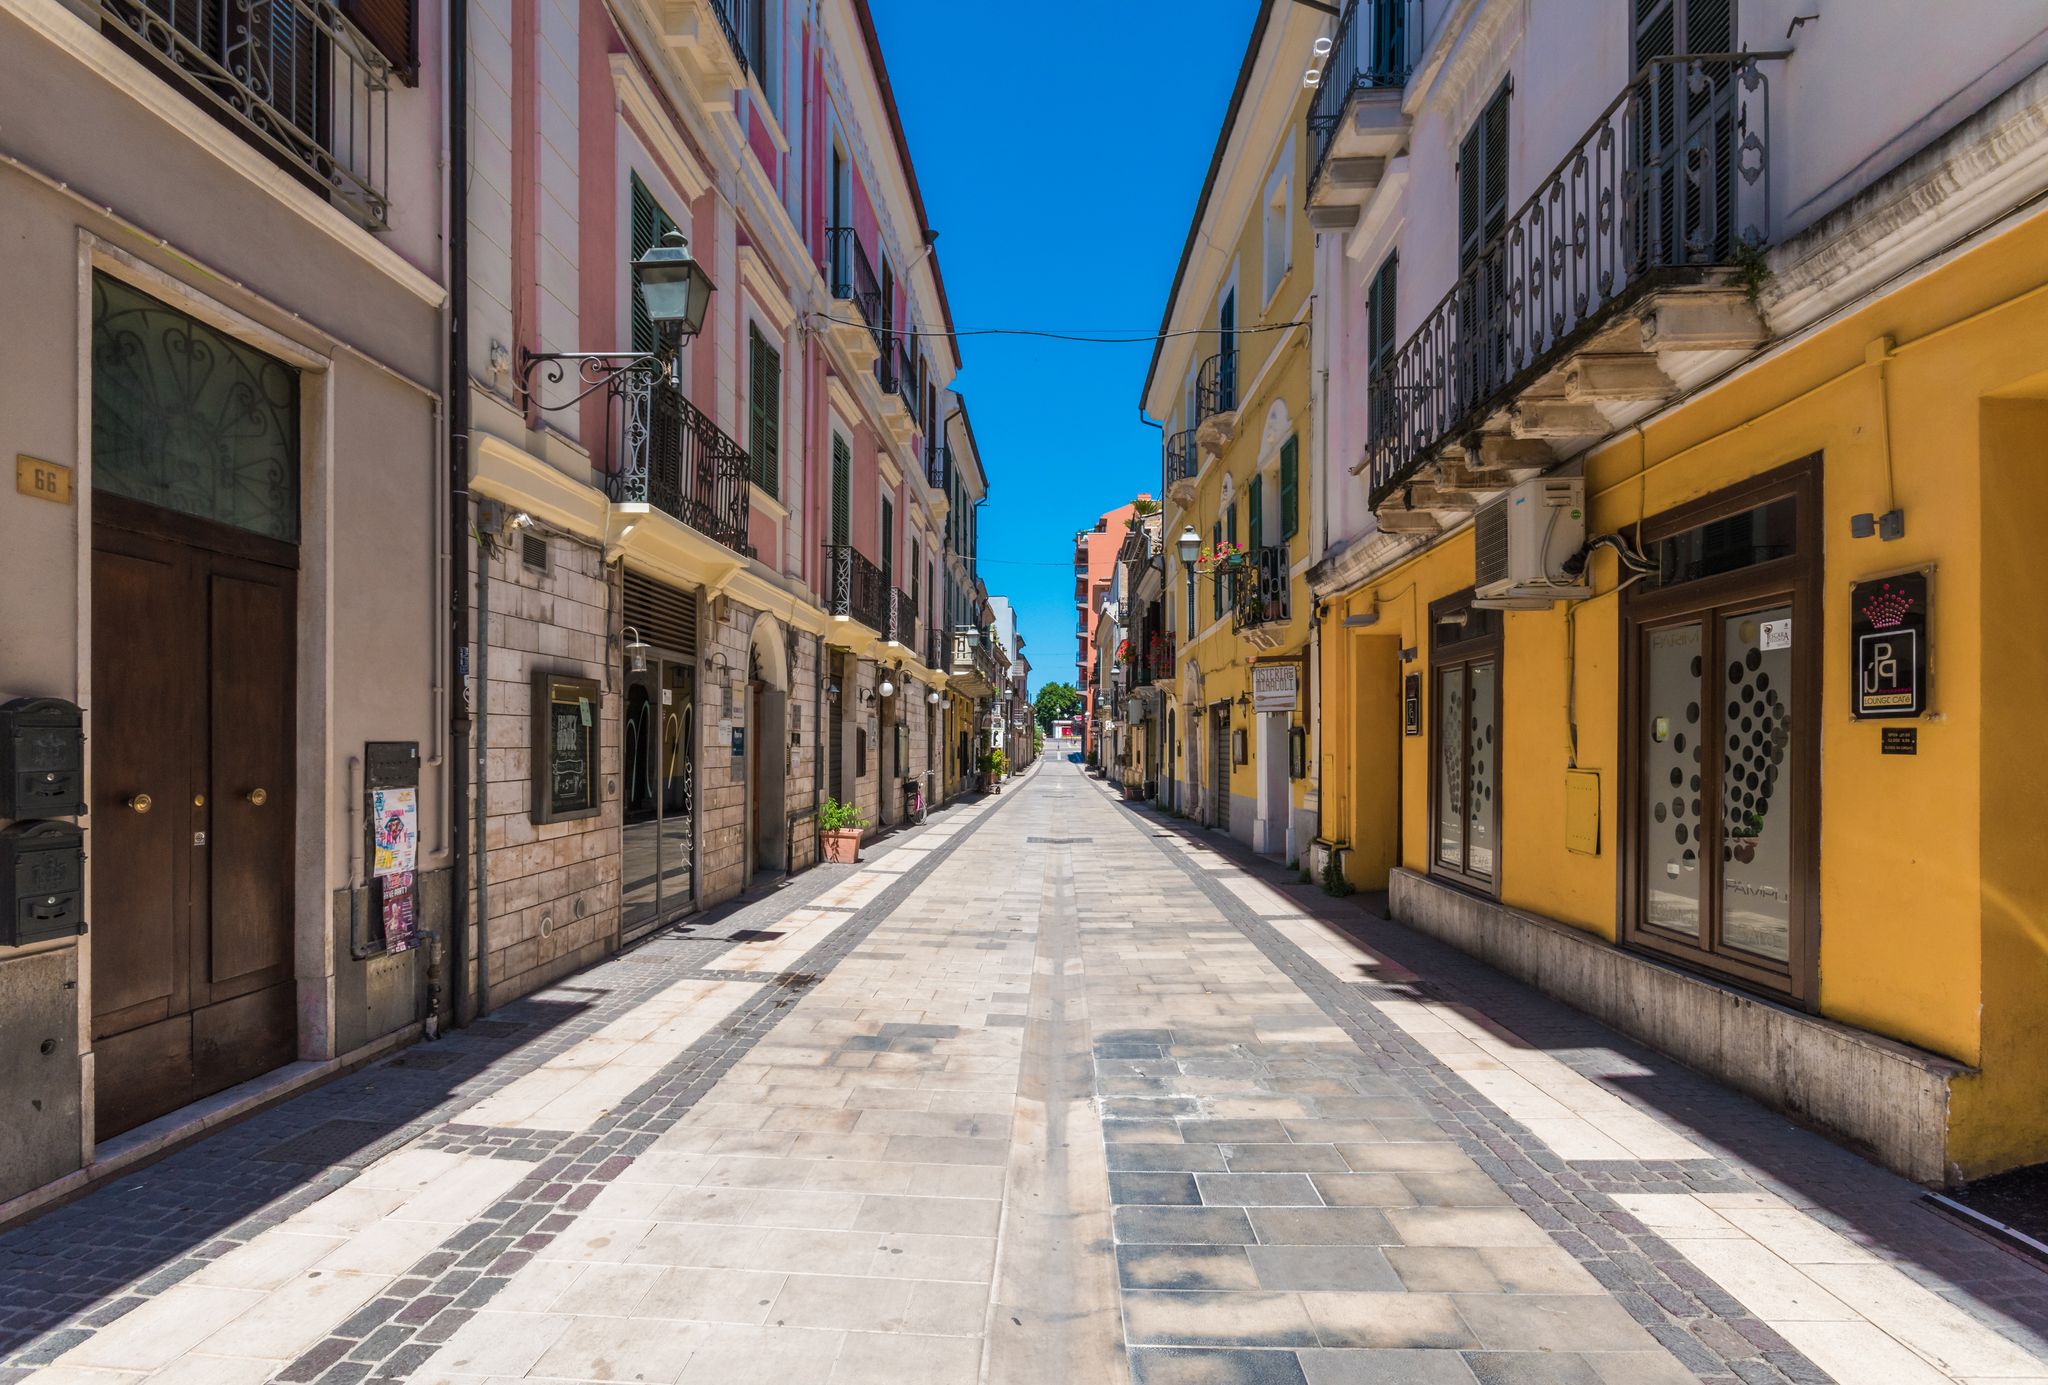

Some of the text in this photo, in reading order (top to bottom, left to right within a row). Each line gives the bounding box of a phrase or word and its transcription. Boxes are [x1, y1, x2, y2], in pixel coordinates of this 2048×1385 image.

[35, 468, 57, 493] 66
[1256, 667, 1289, 681] OSTERIA
[1864, 695, 1891, 705] LOUNGE
